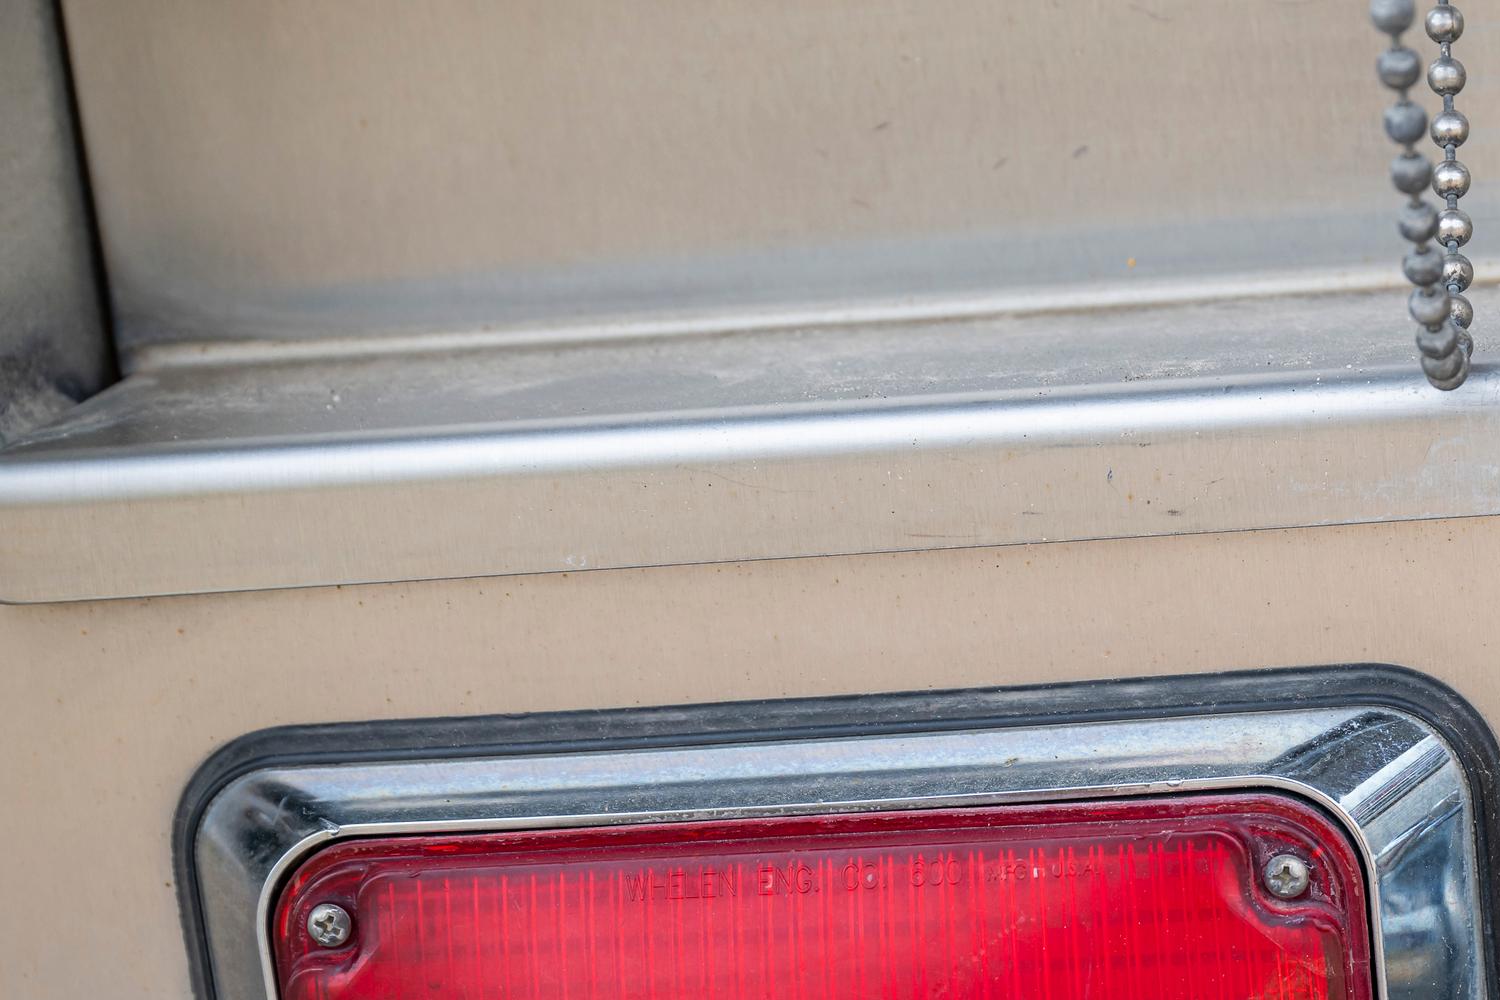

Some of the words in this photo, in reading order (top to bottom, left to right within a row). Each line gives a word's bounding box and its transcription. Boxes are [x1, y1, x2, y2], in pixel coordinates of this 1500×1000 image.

[624, 869, 737, 901] WHELEN
[757, 863, 821, 897] ENG.
[840, 861, 888, 892] CO.
[910, 858, 963, 889] 600
